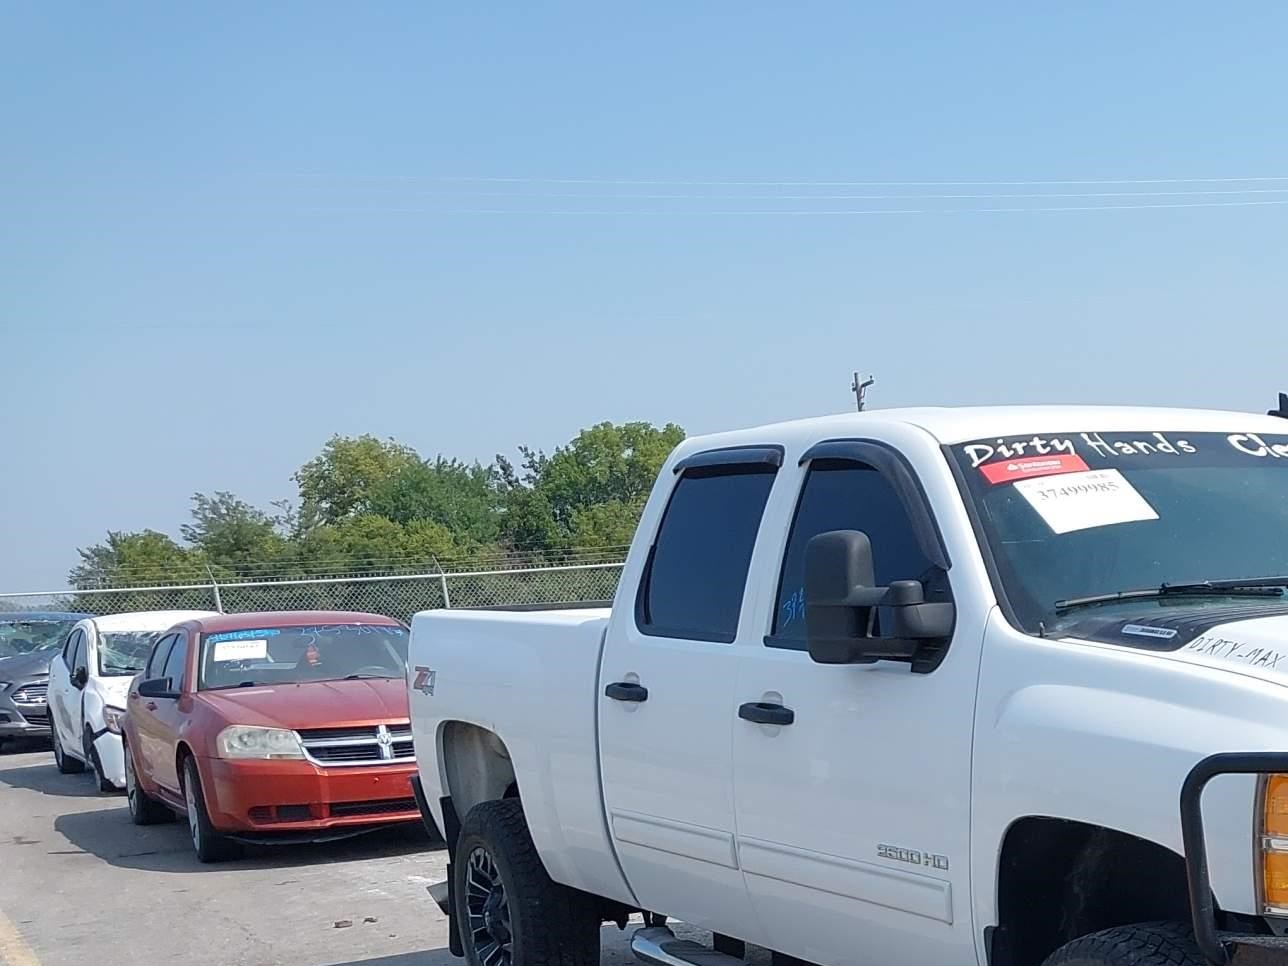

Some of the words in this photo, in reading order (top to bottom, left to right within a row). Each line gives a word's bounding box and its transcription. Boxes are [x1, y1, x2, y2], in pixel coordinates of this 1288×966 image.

[963, 436, 1076, 468] Dirty
[1080, 432, 1196, 458] Hands
[1037, 481, 1121, 502] 37499985
